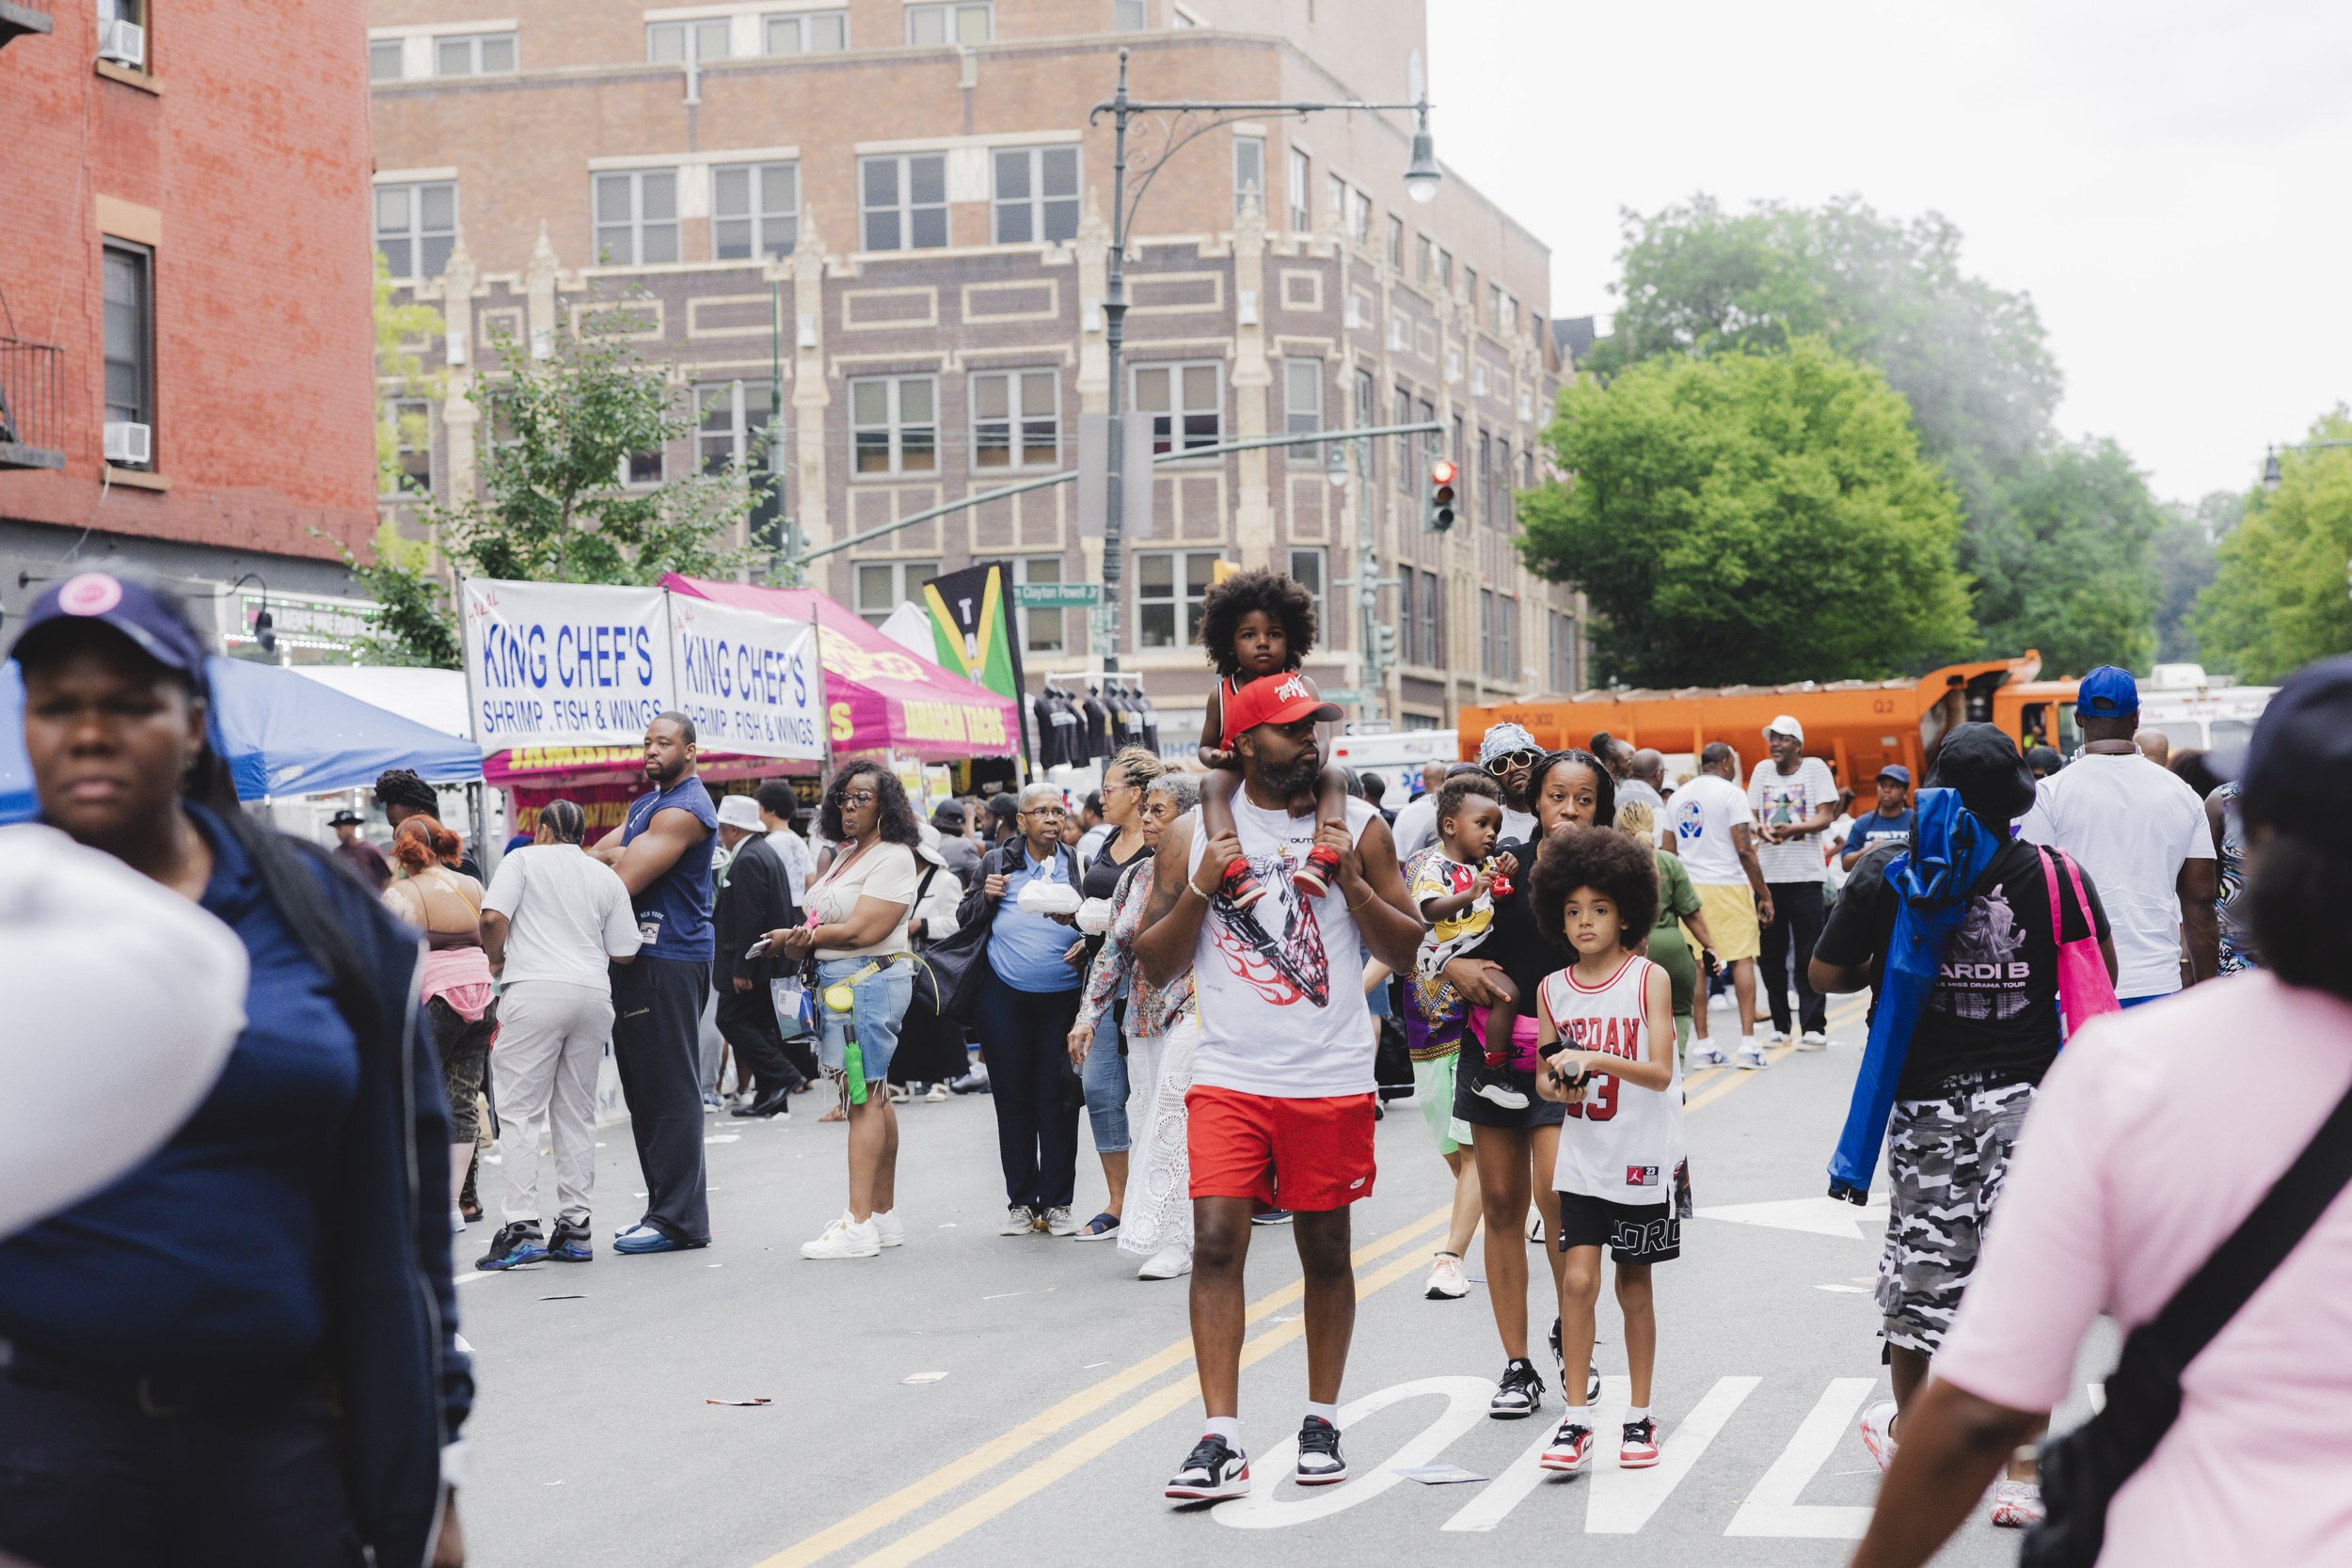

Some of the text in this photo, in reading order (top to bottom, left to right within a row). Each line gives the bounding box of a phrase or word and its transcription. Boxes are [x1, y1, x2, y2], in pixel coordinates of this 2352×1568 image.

[1022, 586, 1057, 602] Clayton
[1057, 586, 1087, 599] Powell
[483, 623, 653, 689] KING CHEF'S
[682, 632, 732, 699] KING
[737, 643, 807, 709] CHEF'S
[482, 699, 544, 734] SHRIMP
[553, 699, 593, 732] FISH
[594, 699, 608, 731] &
[734, 710, 764, 741] FISH
[764, 714, 775, 743] &
[774, 715, 815, 746] WINGS
[962, 704, 1008, 747] TACOS
[640, 910, 664, 921] NEW YORK
[1940, 961, 2031, 980] ARDI B
[1645, 1166, 1656, 1176] 23
[1211, 1374, 1880, 1539] ONL
